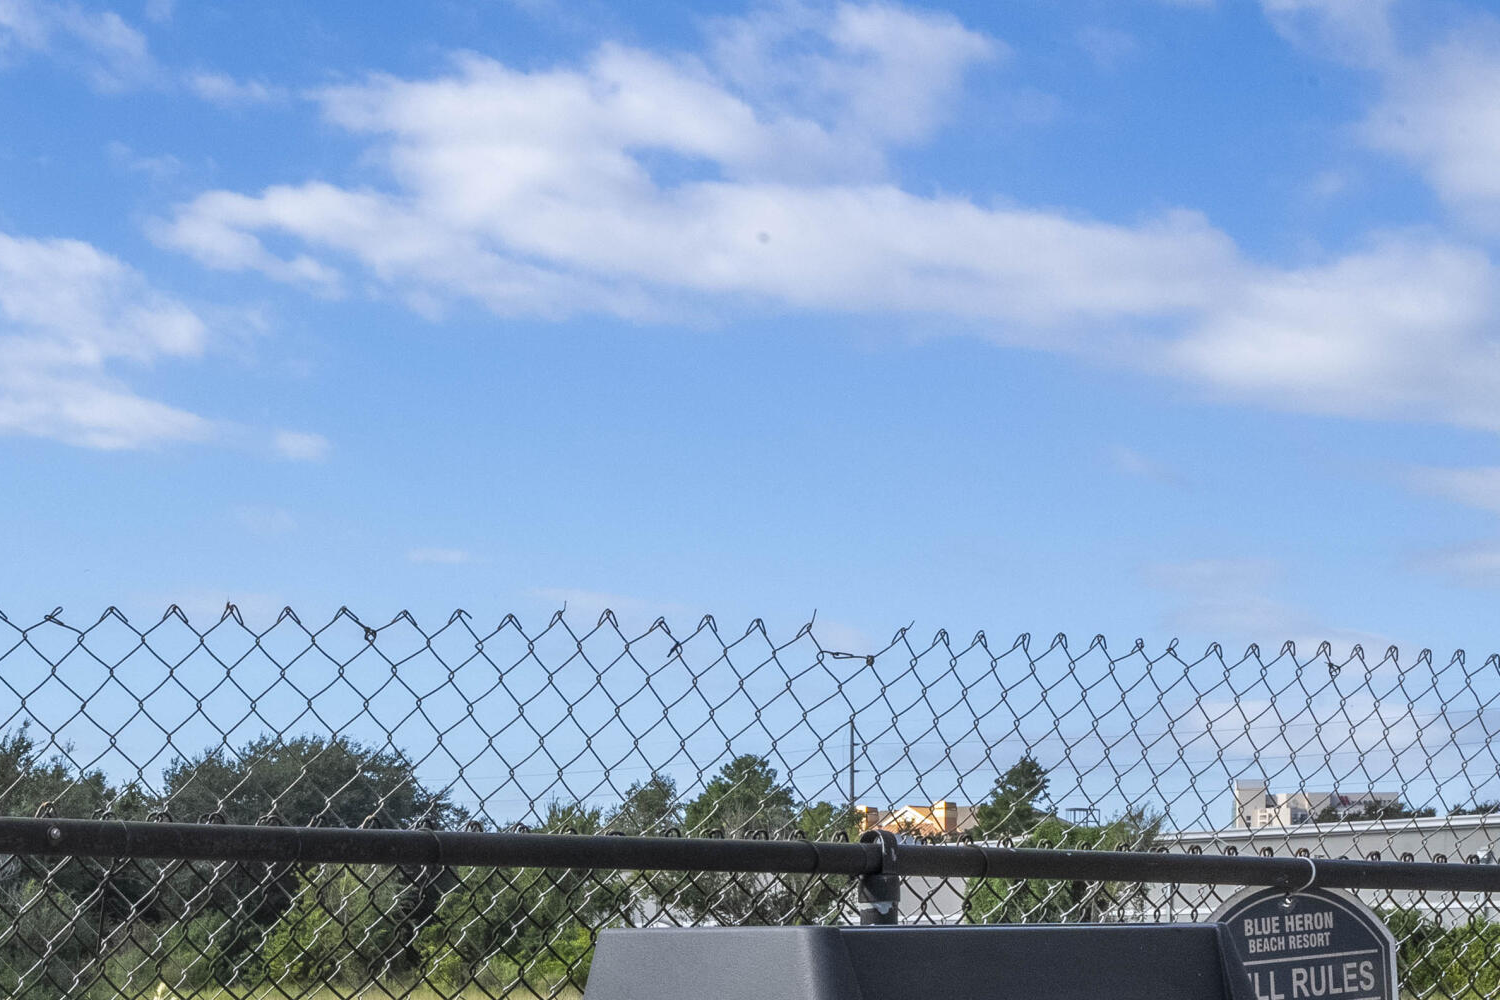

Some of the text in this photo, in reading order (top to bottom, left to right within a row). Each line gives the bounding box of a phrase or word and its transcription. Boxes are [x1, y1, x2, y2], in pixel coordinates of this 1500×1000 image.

[1244, 912, 1334, 936] BLUE HERON
[1248, 932, 1331, 954] BEACH RESORT
[1292, 960, 1375, 999] RULES
